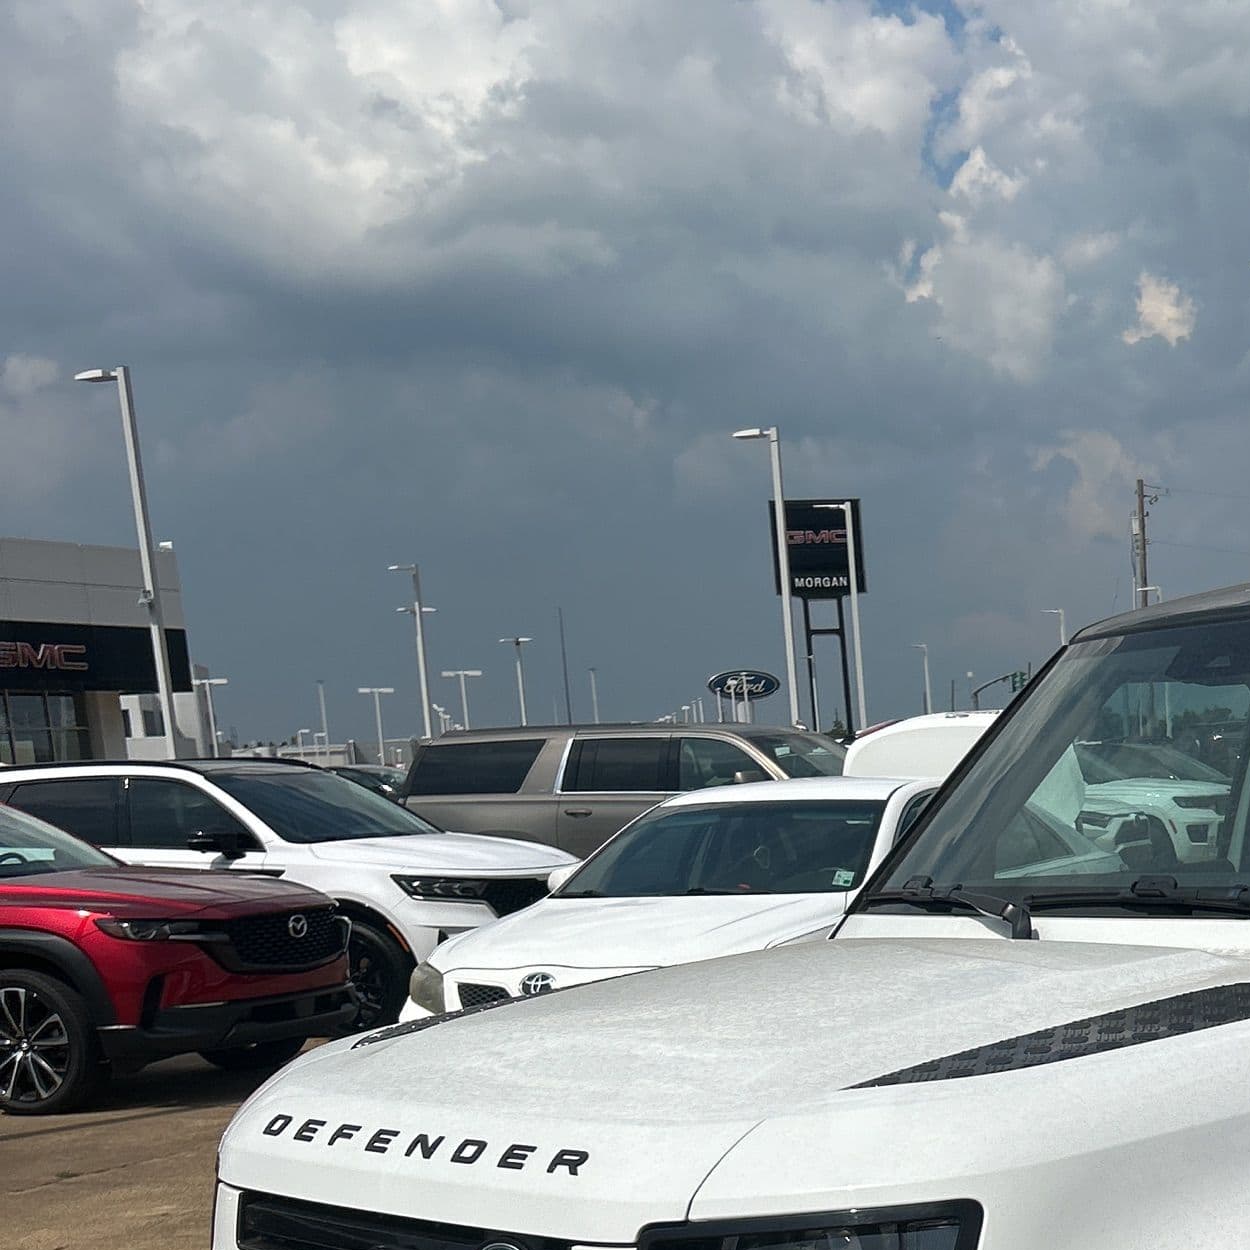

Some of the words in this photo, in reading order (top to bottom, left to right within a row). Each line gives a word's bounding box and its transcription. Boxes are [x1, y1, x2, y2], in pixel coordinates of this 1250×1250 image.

[785, 529, 848, 544] GMC
[795, 576, 848, 588] MORGAN
[723, 675, 766, 693] Ford
[262, 1113, 590, 1177] DEFENDER
